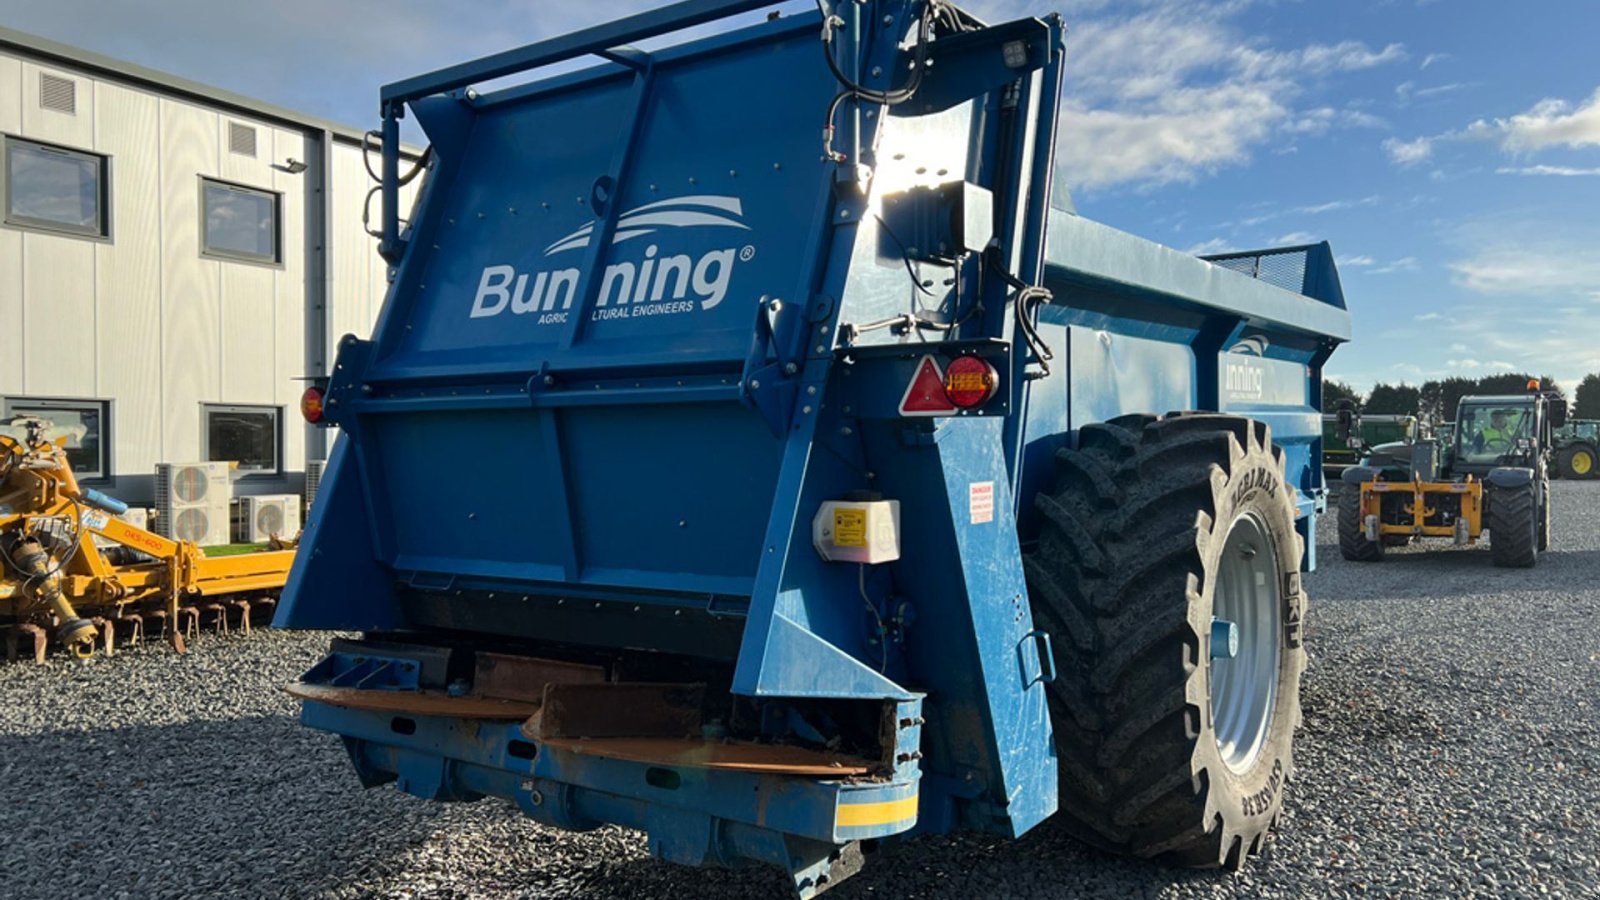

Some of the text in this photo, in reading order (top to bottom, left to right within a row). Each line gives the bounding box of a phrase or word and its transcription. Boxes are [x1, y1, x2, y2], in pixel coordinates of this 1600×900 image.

[469, 244, 736, 319] Bunning
[537, 301, 694, 326] AGRICLTURAL ENGINEERS
